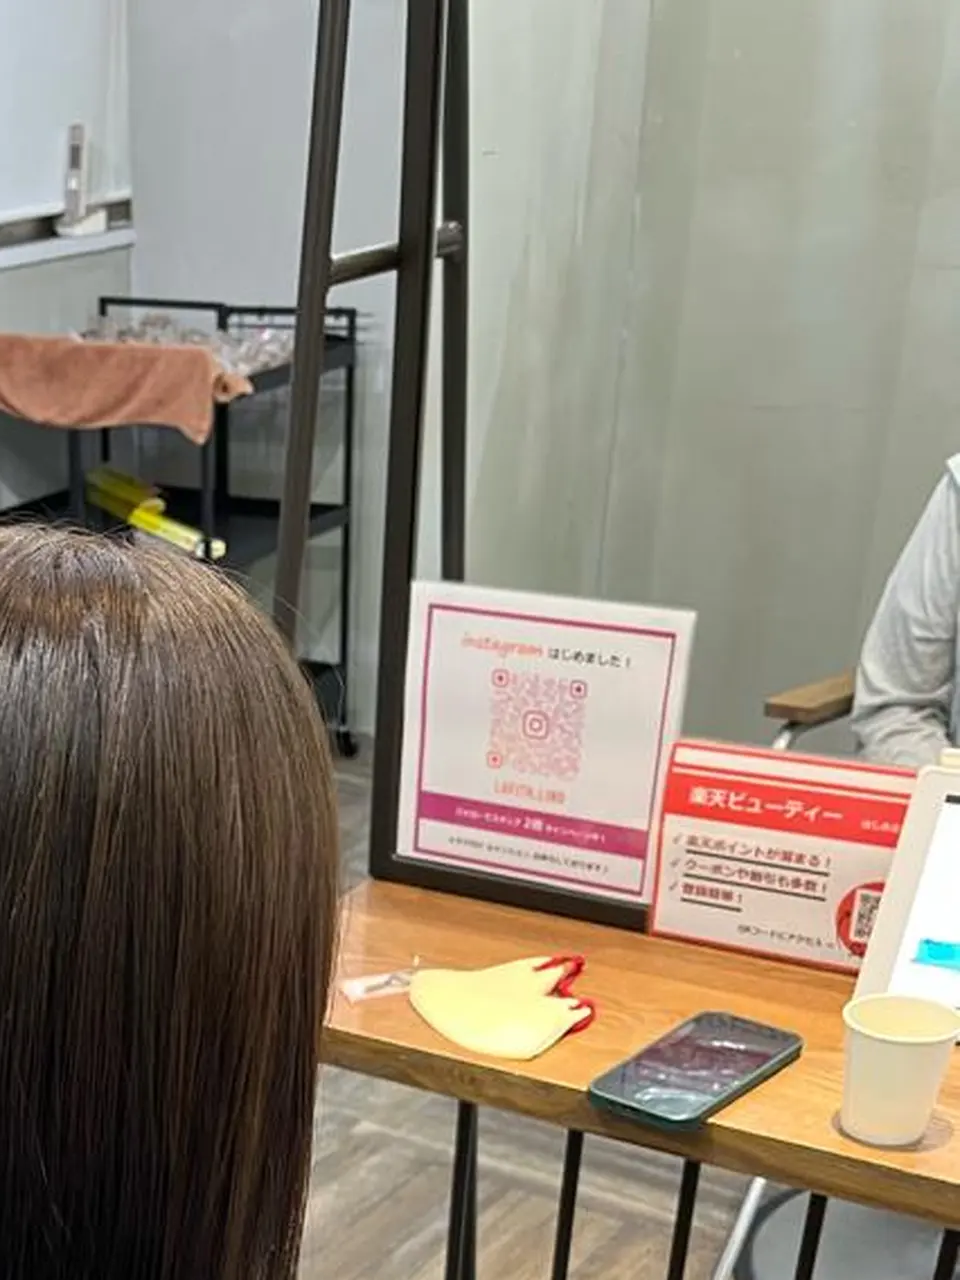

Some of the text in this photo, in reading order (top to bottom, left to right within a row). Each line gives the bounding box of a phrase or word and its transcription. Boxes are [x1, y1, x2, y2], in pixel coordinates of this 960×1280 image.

[690, 786, 843, 821] 楽天ビューティー
